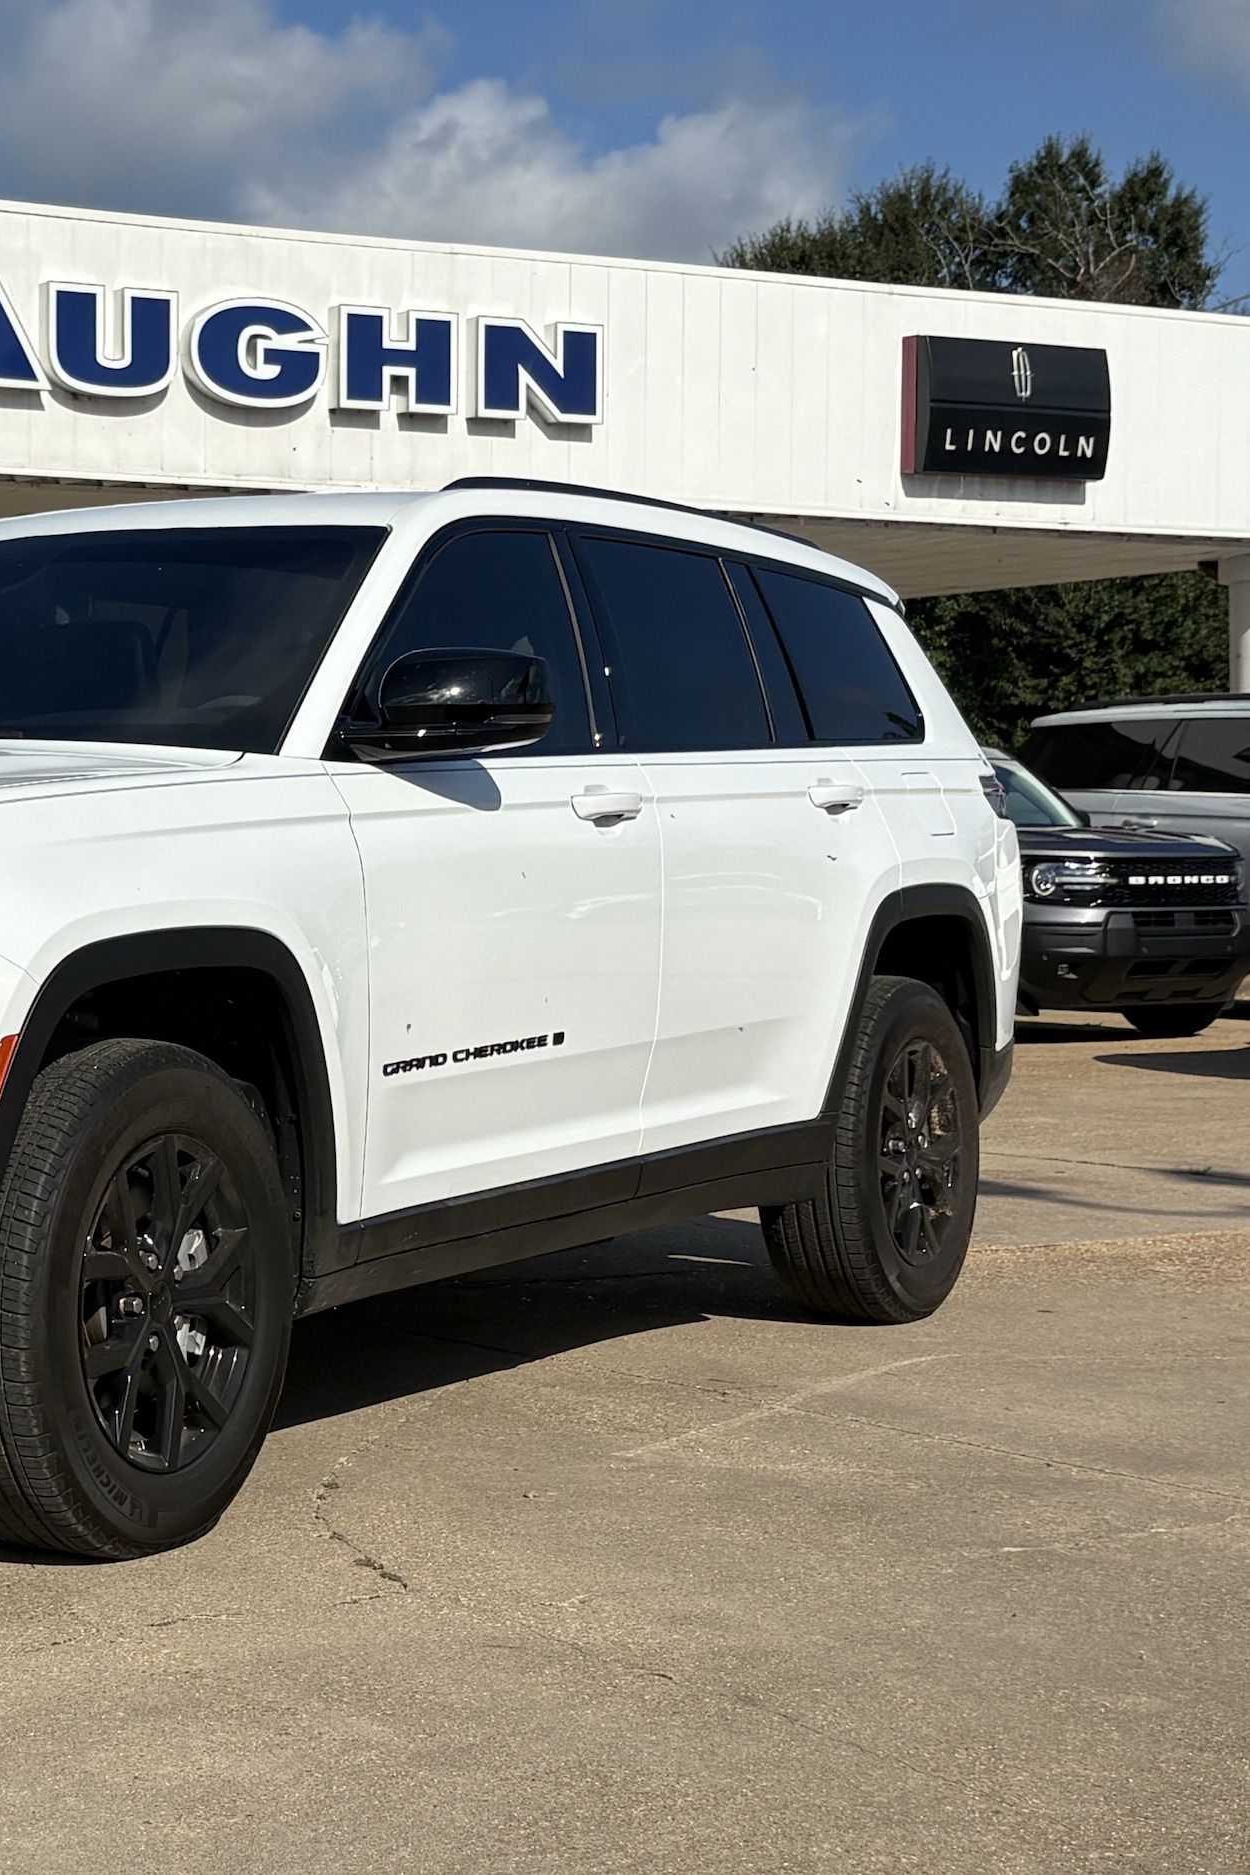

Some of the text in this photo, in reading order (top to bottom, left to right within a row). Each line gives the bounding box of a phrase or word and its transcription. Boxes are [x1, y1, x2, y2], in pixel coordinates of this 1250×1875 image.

[944, 428, 1095, 458] LINCOLN
[1128, 875, 1230, 885] BRONCO
[382, 1034, 549, 1077] GRAND CHEROKEE
[71, 1413, 129, 1508] MICHELIN
